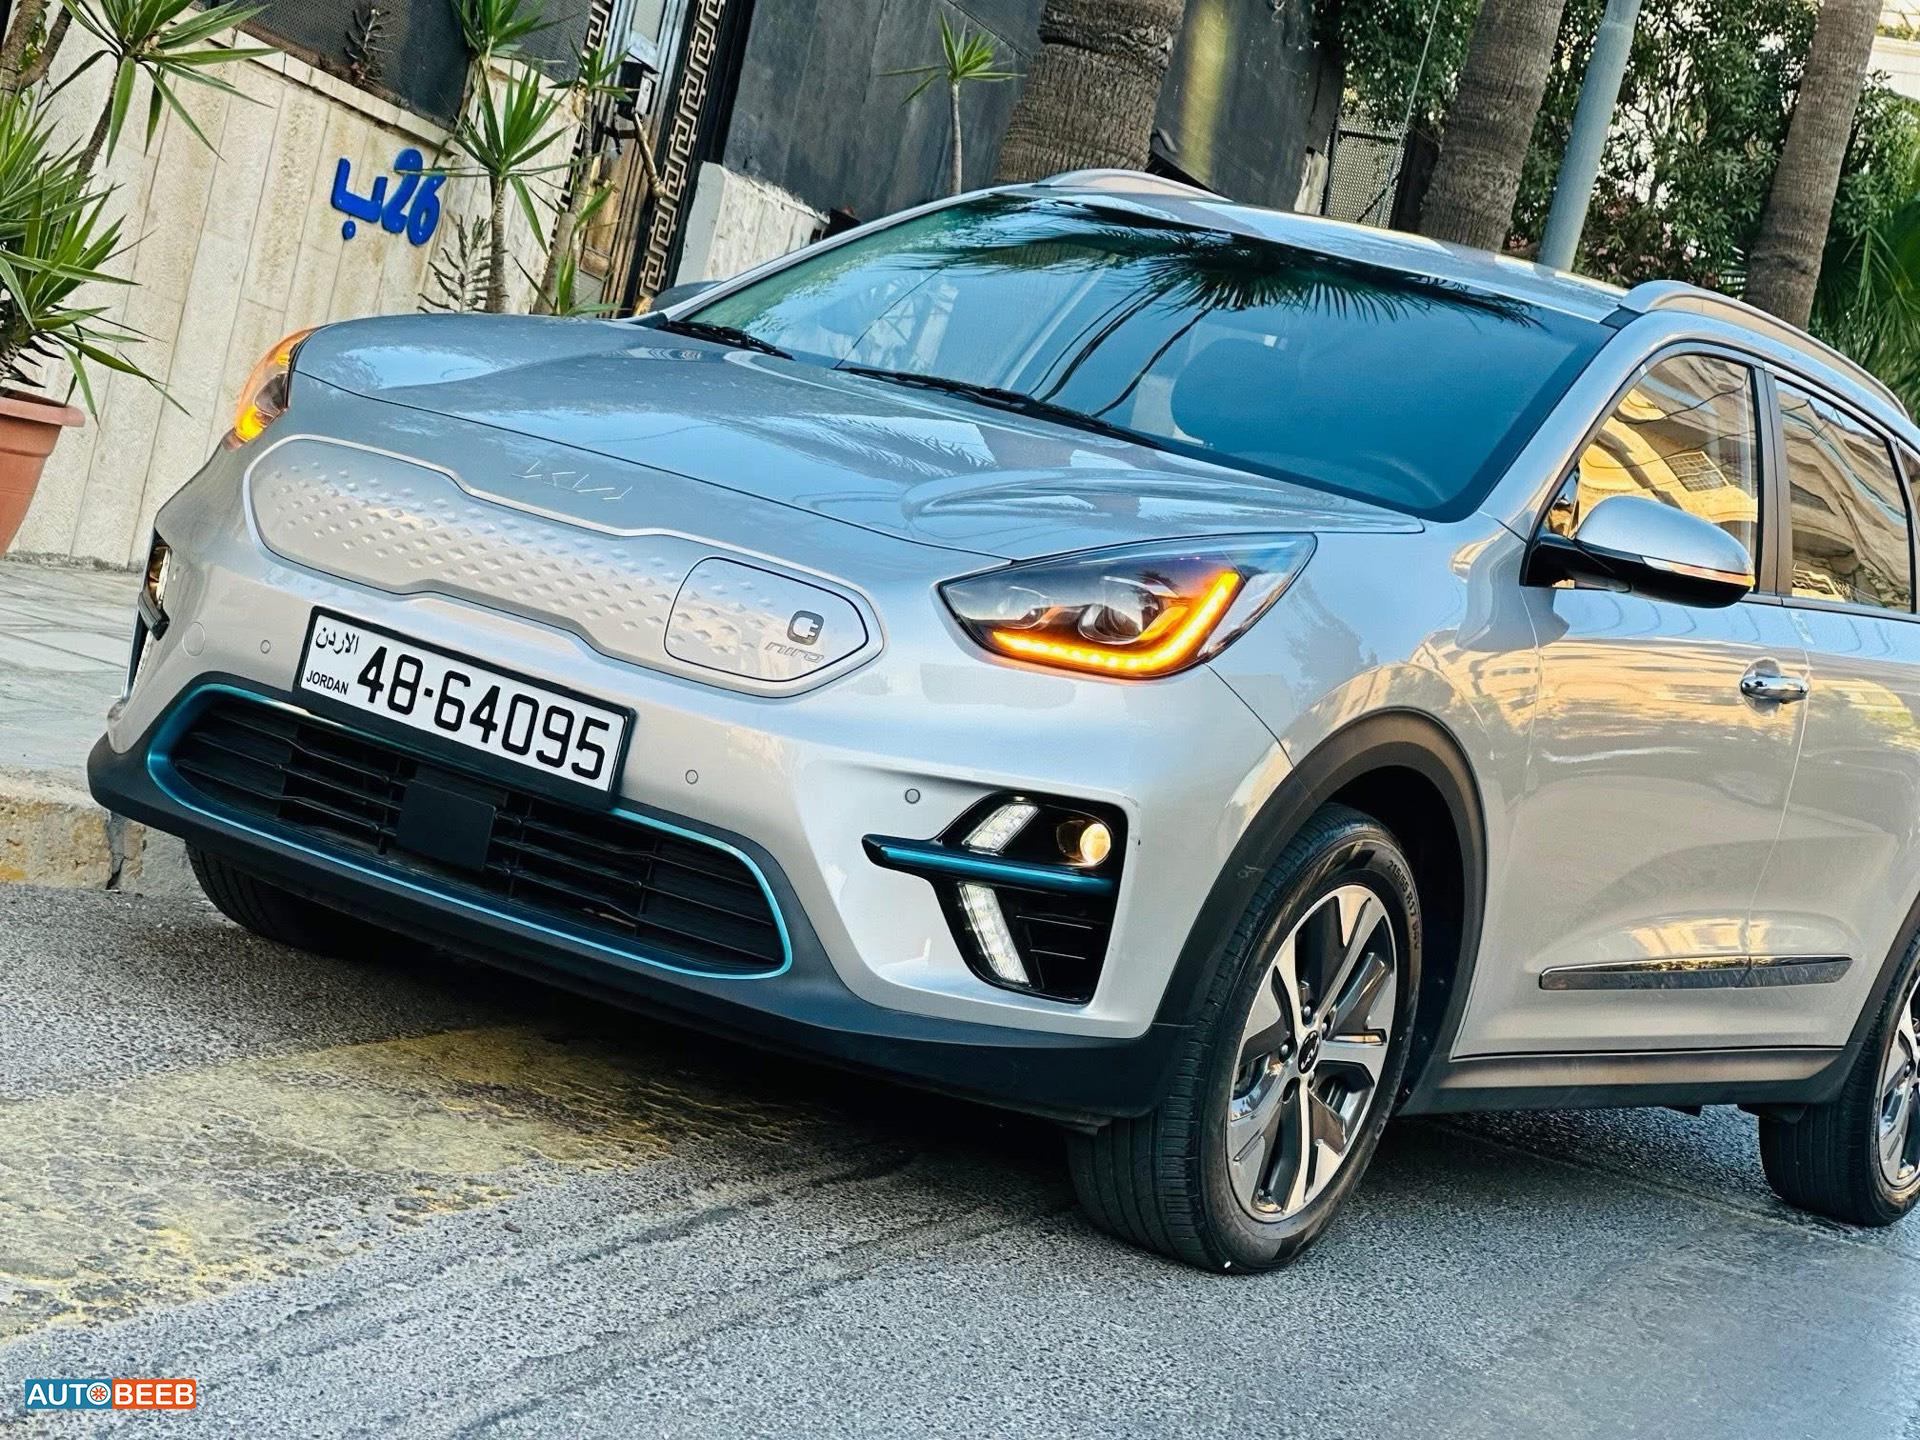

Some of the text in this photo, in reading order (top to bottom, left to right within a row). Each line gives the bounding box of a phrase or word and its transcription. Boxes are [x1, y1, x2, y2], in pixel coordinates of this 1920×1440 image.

[315, 626, 360, 655] الاردن
[306, 670, 349, 696] JORDAN
[357, 646, 611, 780] 48-64095
[1387, 860, 1410, 893] 215/55
[1406, 891, 1417, 917] R17
